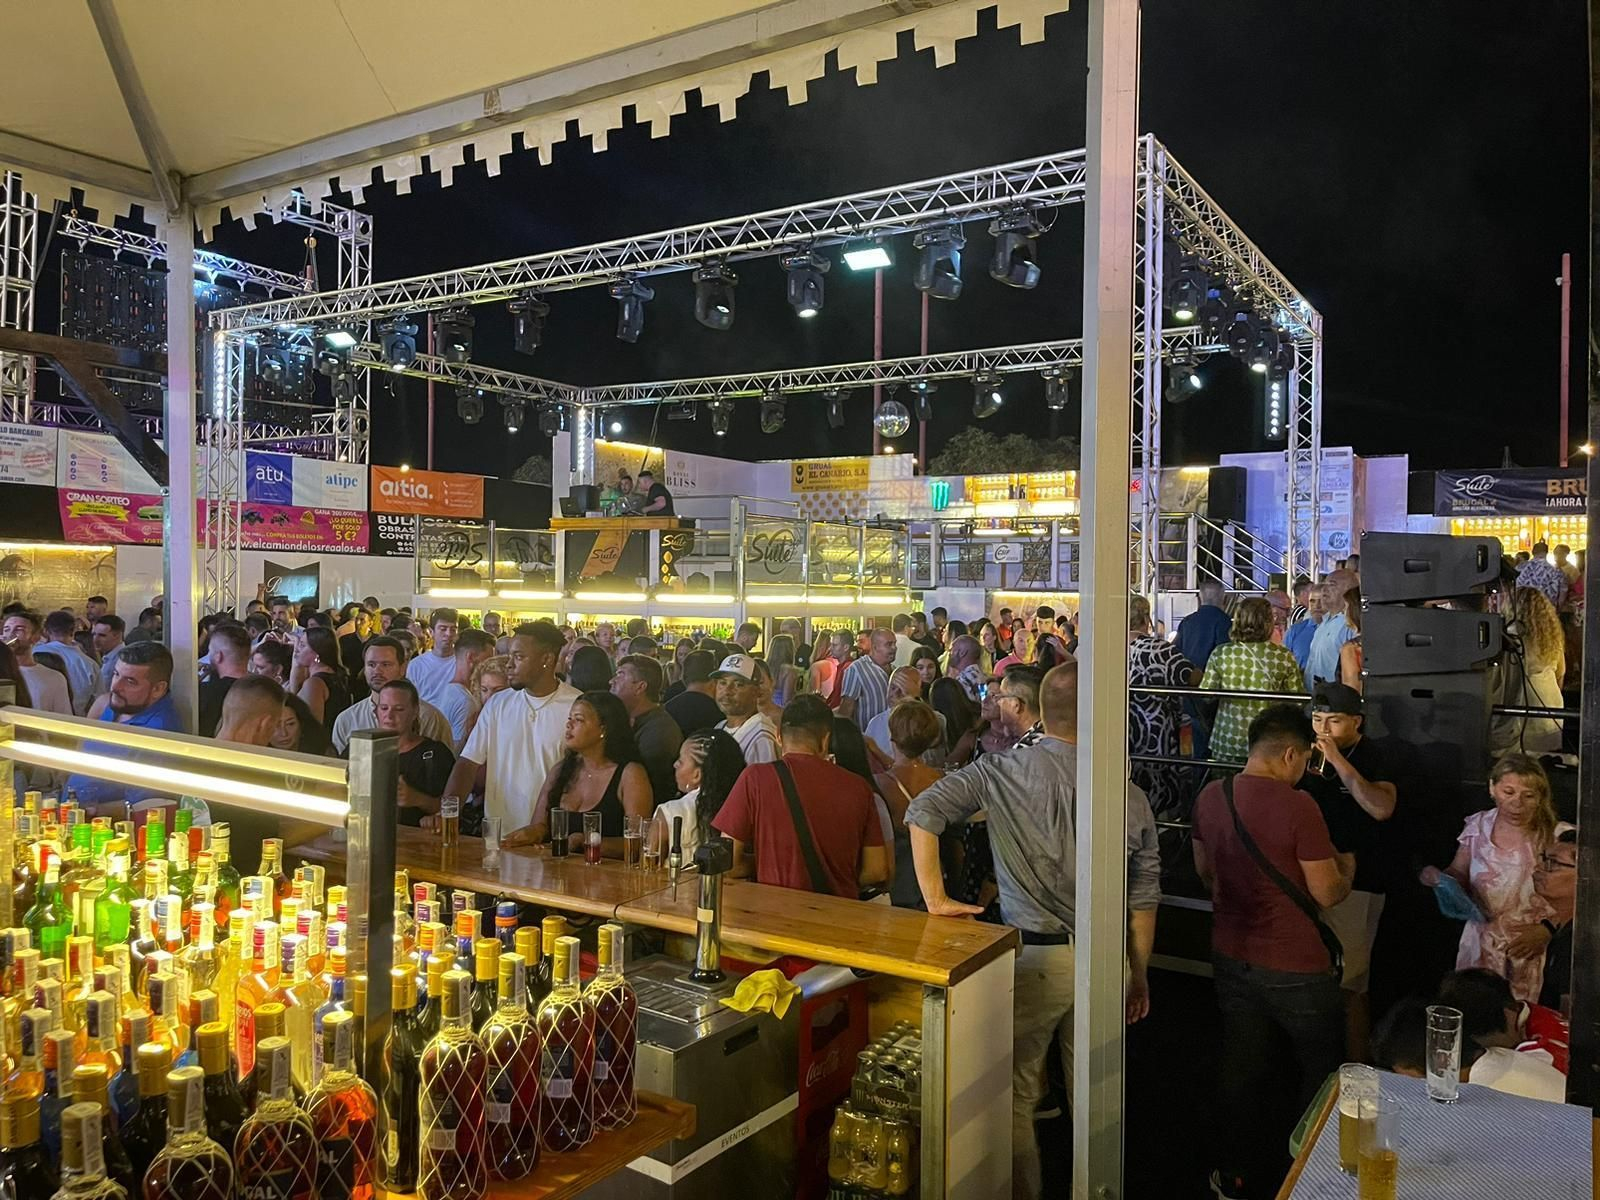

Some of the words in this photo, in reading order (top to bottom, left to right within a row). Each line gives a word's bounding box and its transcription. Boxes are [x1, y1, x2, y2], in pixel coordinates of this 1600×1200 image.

[256, 466, 283, 482] atu
[666, 476, 697, 488] BLISS
[1452, 476, 1492, 494] Suite
[66, 492, 95, 502] GRAN
[95, 495, 130, 506] SORTEO
[1546, 497, 1582, 507] ¡AHORA
[336, 530, 343, 540] 5
[378, 525, 415, 534] OBRAS
[661, 534, 687, 550] Suite
[748, 531, 794, 567] Suite
[591, 548, 618, 563] Suite
[720, 1126, 750, 1148] EVENTOS
